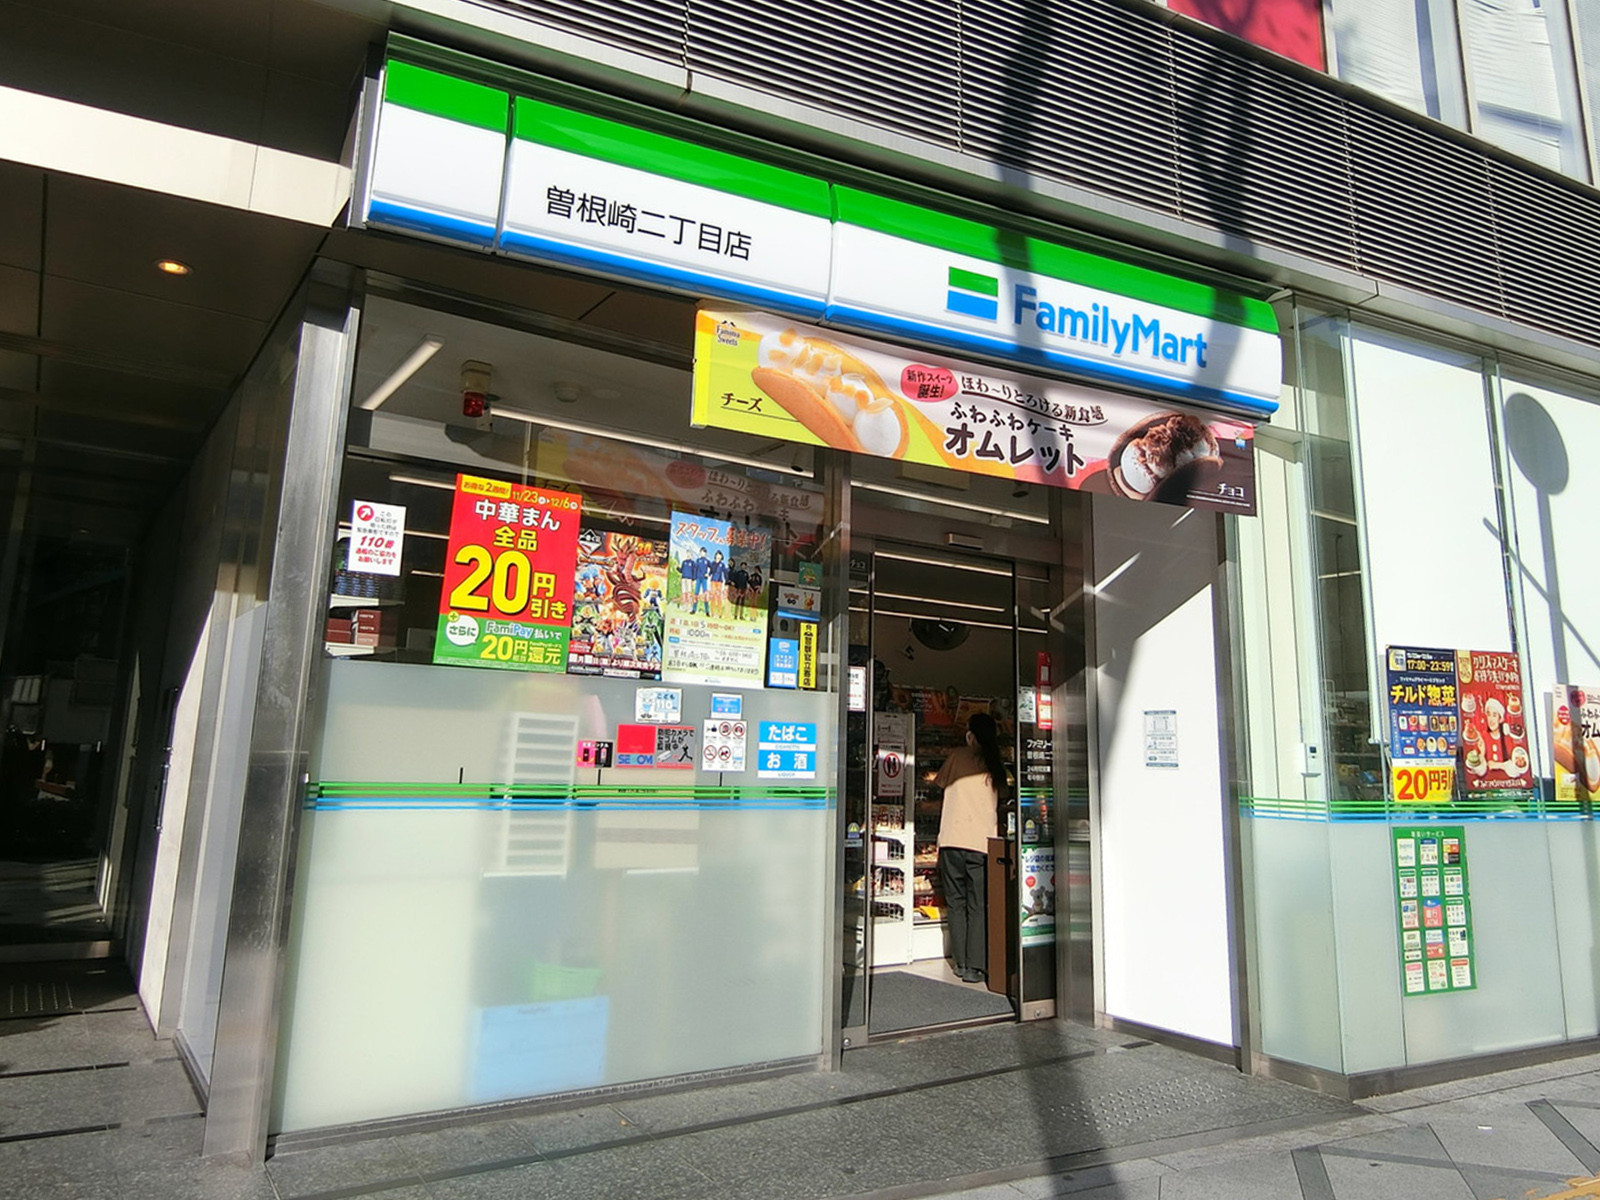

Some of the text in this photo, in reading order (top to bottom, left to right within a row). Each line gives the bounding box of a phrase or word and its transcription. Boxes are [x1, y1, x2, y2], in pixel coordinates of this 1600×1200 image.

[546, 184, 752, 261] 曽根崎二丁目店
[1014, 283, 1208, 368] FamilyMart
[717, 335, 738, 346] Sweets
[906, 369, 953, 385] 新作スイーツ
[721, 391, 763, 412] チーズ
[950, 401, 1074, 442] ふわふわケーキ
[945, 422, 1085, 476] オムレット
[1217, 482, 1245, 498] チョコ
[474, 499, 561, 531] 中華まん
[360, 535, 395, 549] 110番
[493, 525, 538, 551] 全品
[530, 598, 568, 620] 引き
[448, 625, 477, 637] さらに
[656, 693, 676, 701] こども
[1390, 684, 1456, 706] チルド惣菜
[768, 724, 808, 741] たばこ
[767, 752, 808, 769] お 酒
